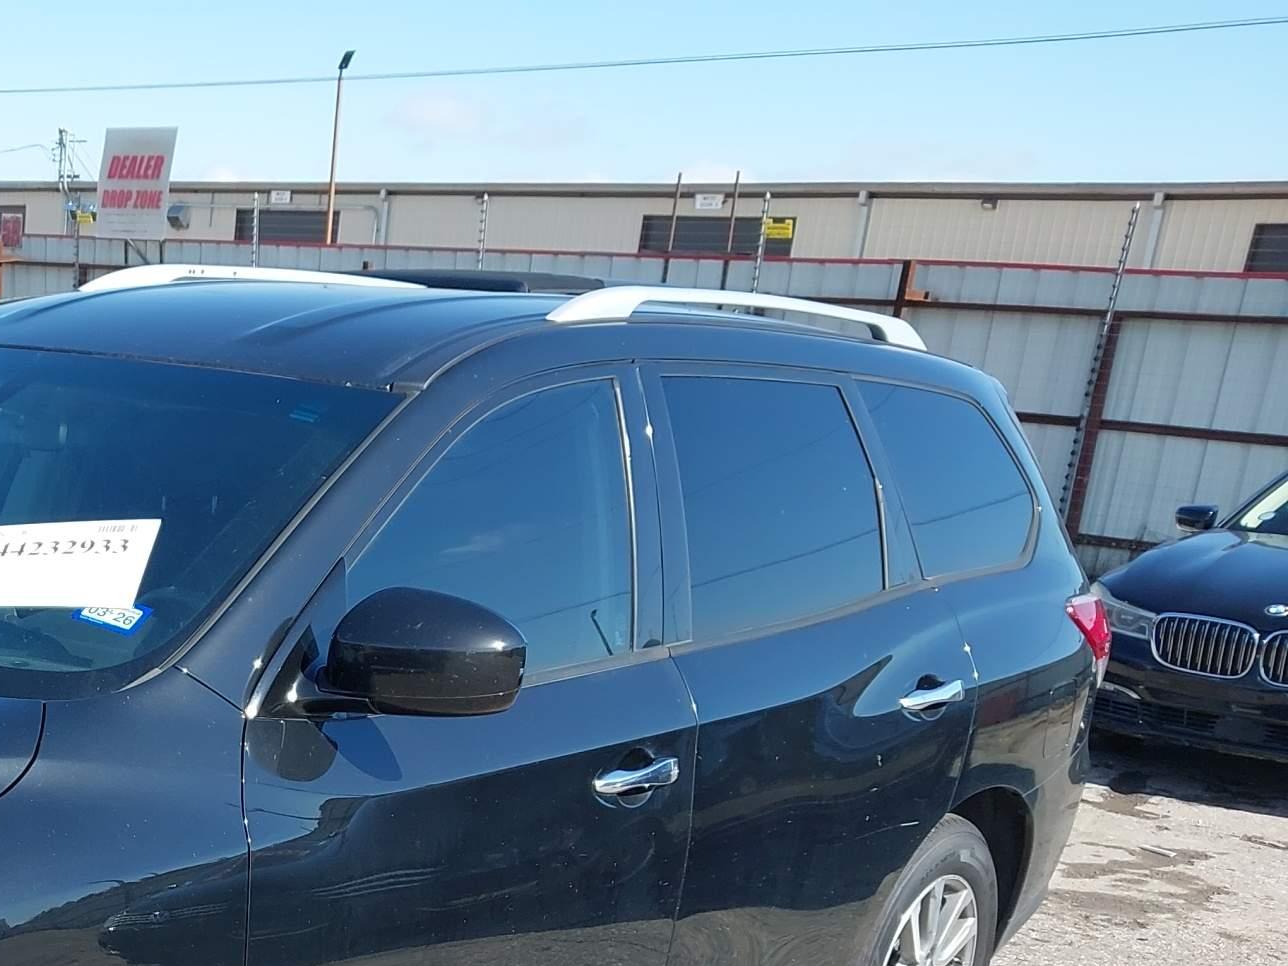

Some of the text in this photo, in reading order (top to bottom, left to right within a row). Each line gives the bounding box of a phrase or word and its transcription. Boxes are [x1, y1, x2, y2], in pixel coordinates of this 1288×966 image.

[107, 154, 165, 180] DEALER
[101, 189, 164, 210] DROP ZONE
